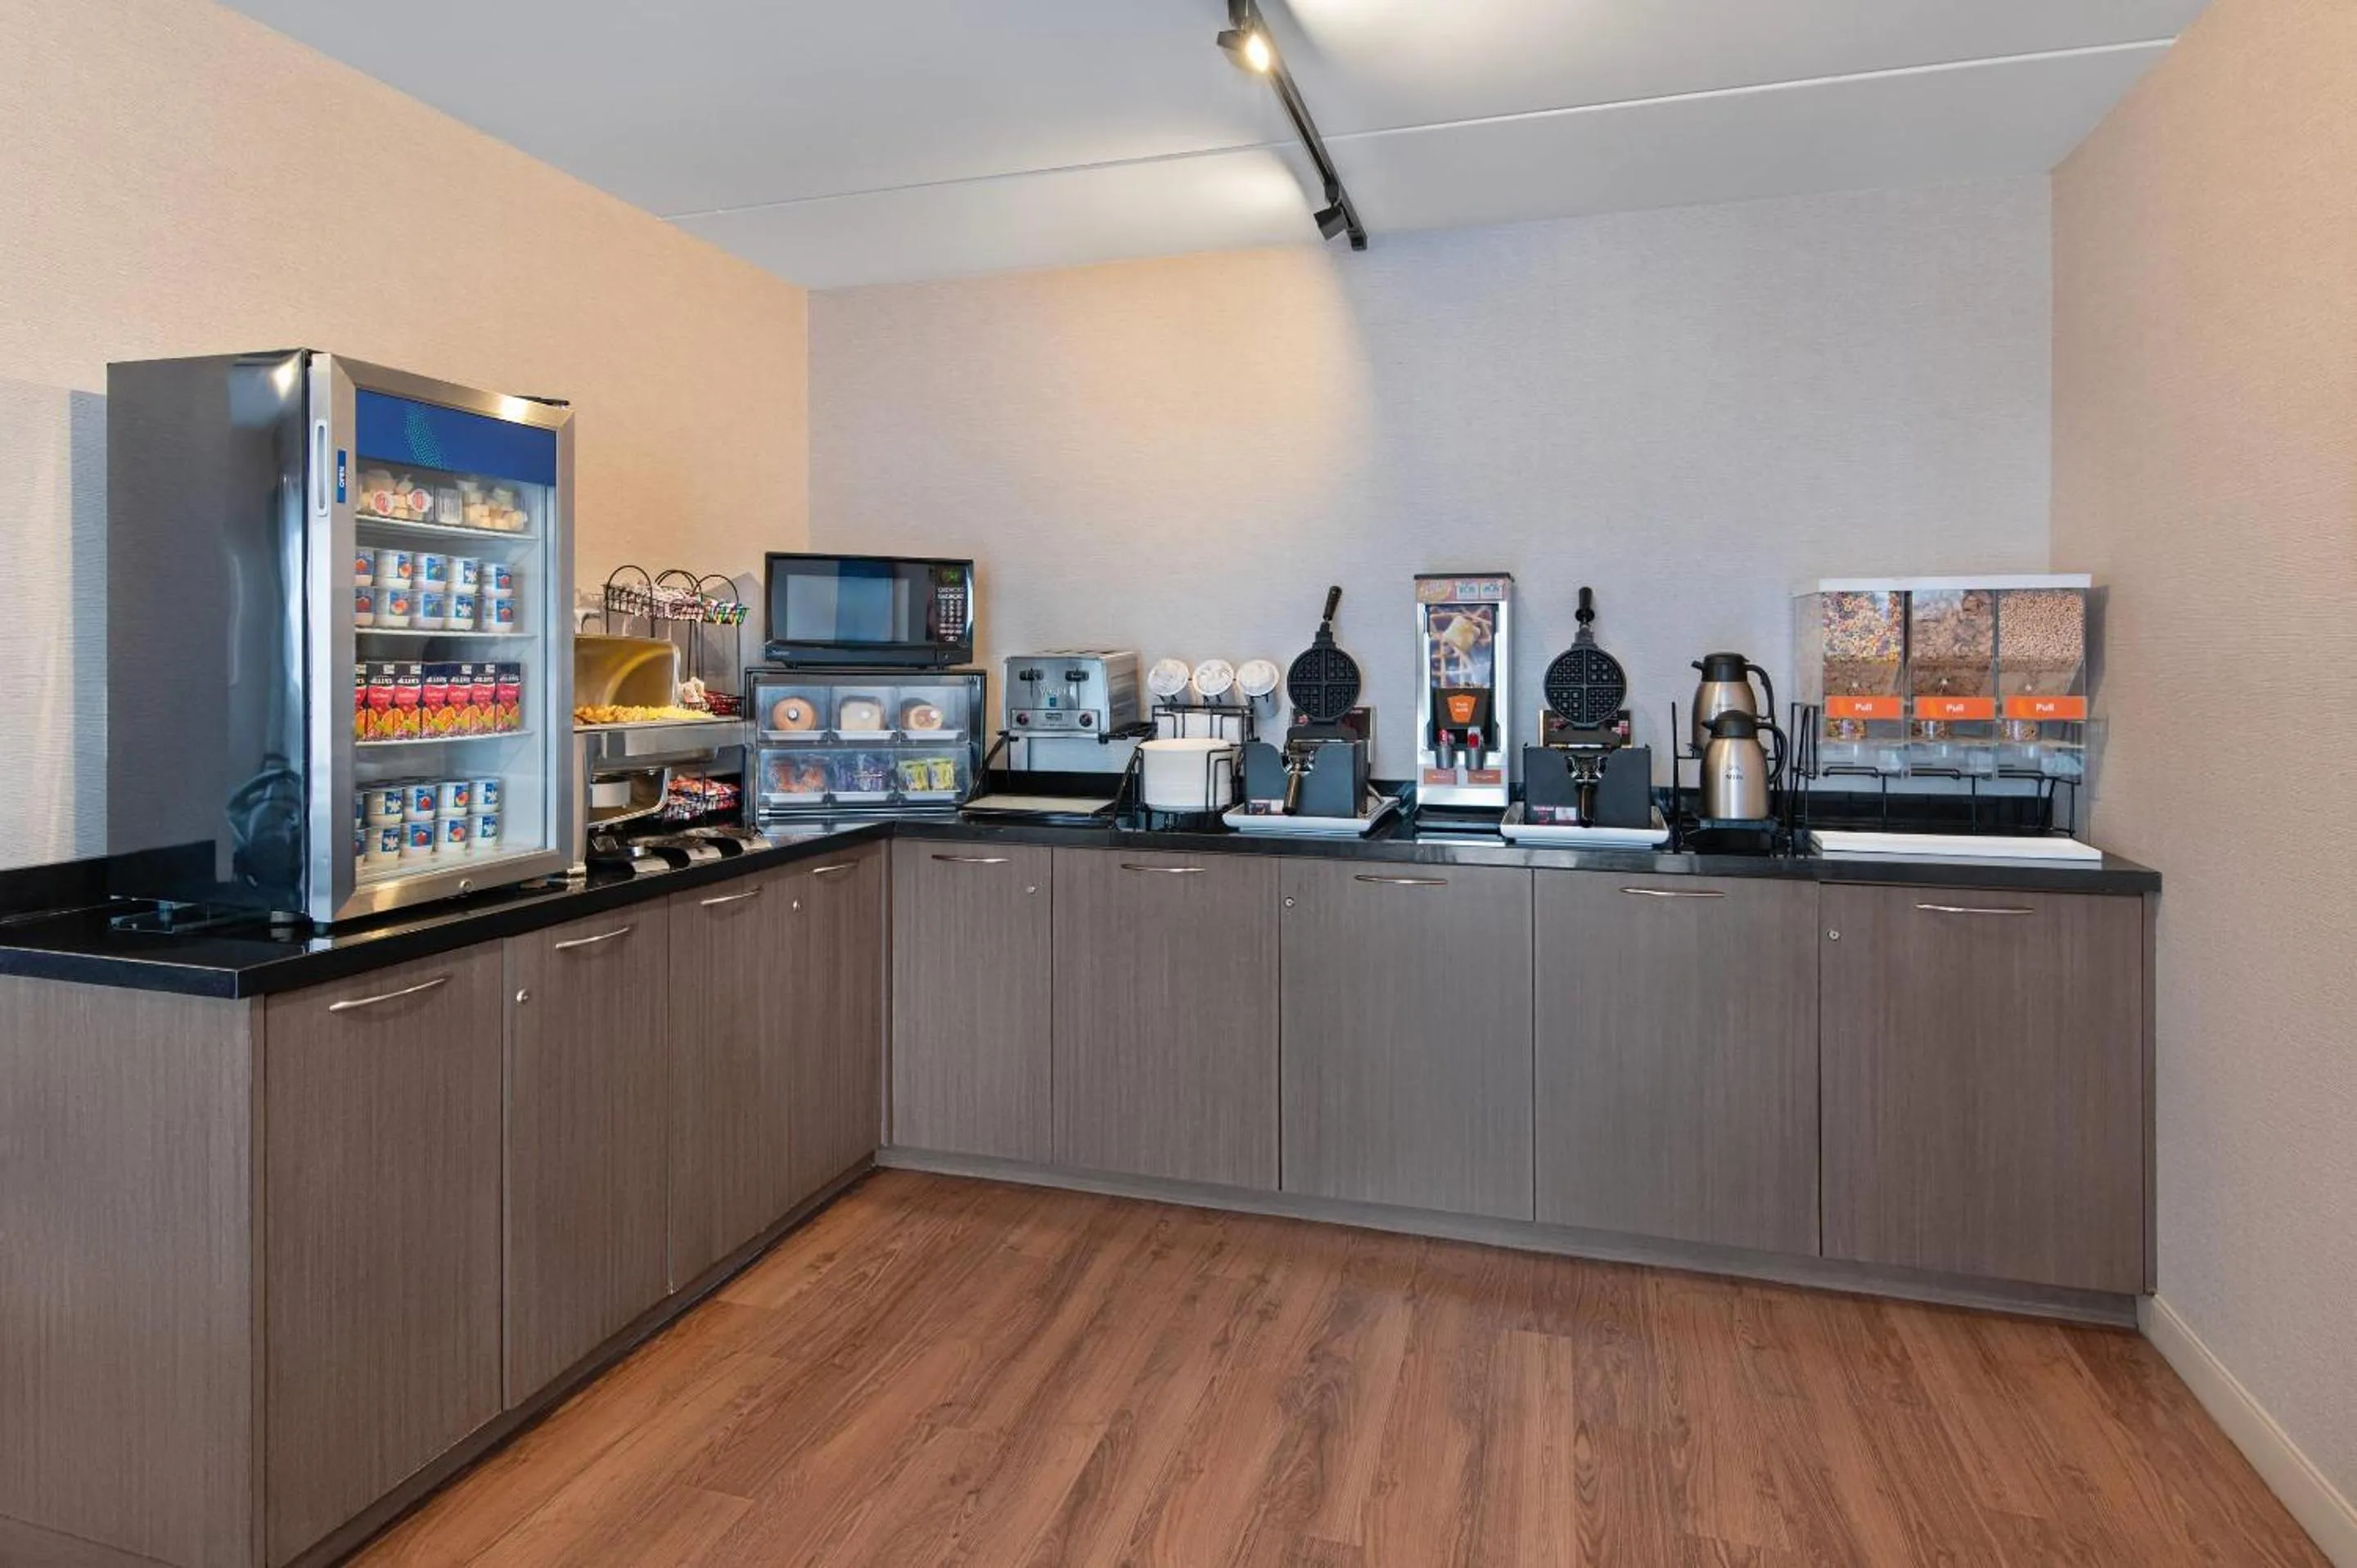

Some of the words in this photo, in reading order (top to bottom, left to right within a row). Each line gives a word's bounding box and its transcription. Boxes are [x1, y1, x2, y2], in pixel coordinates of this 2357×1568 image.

[1855, 703, 1873, 711] Pull
[1945, 703, 1964, 713] Pull
[2035, 703, 2055, 711] Pull
